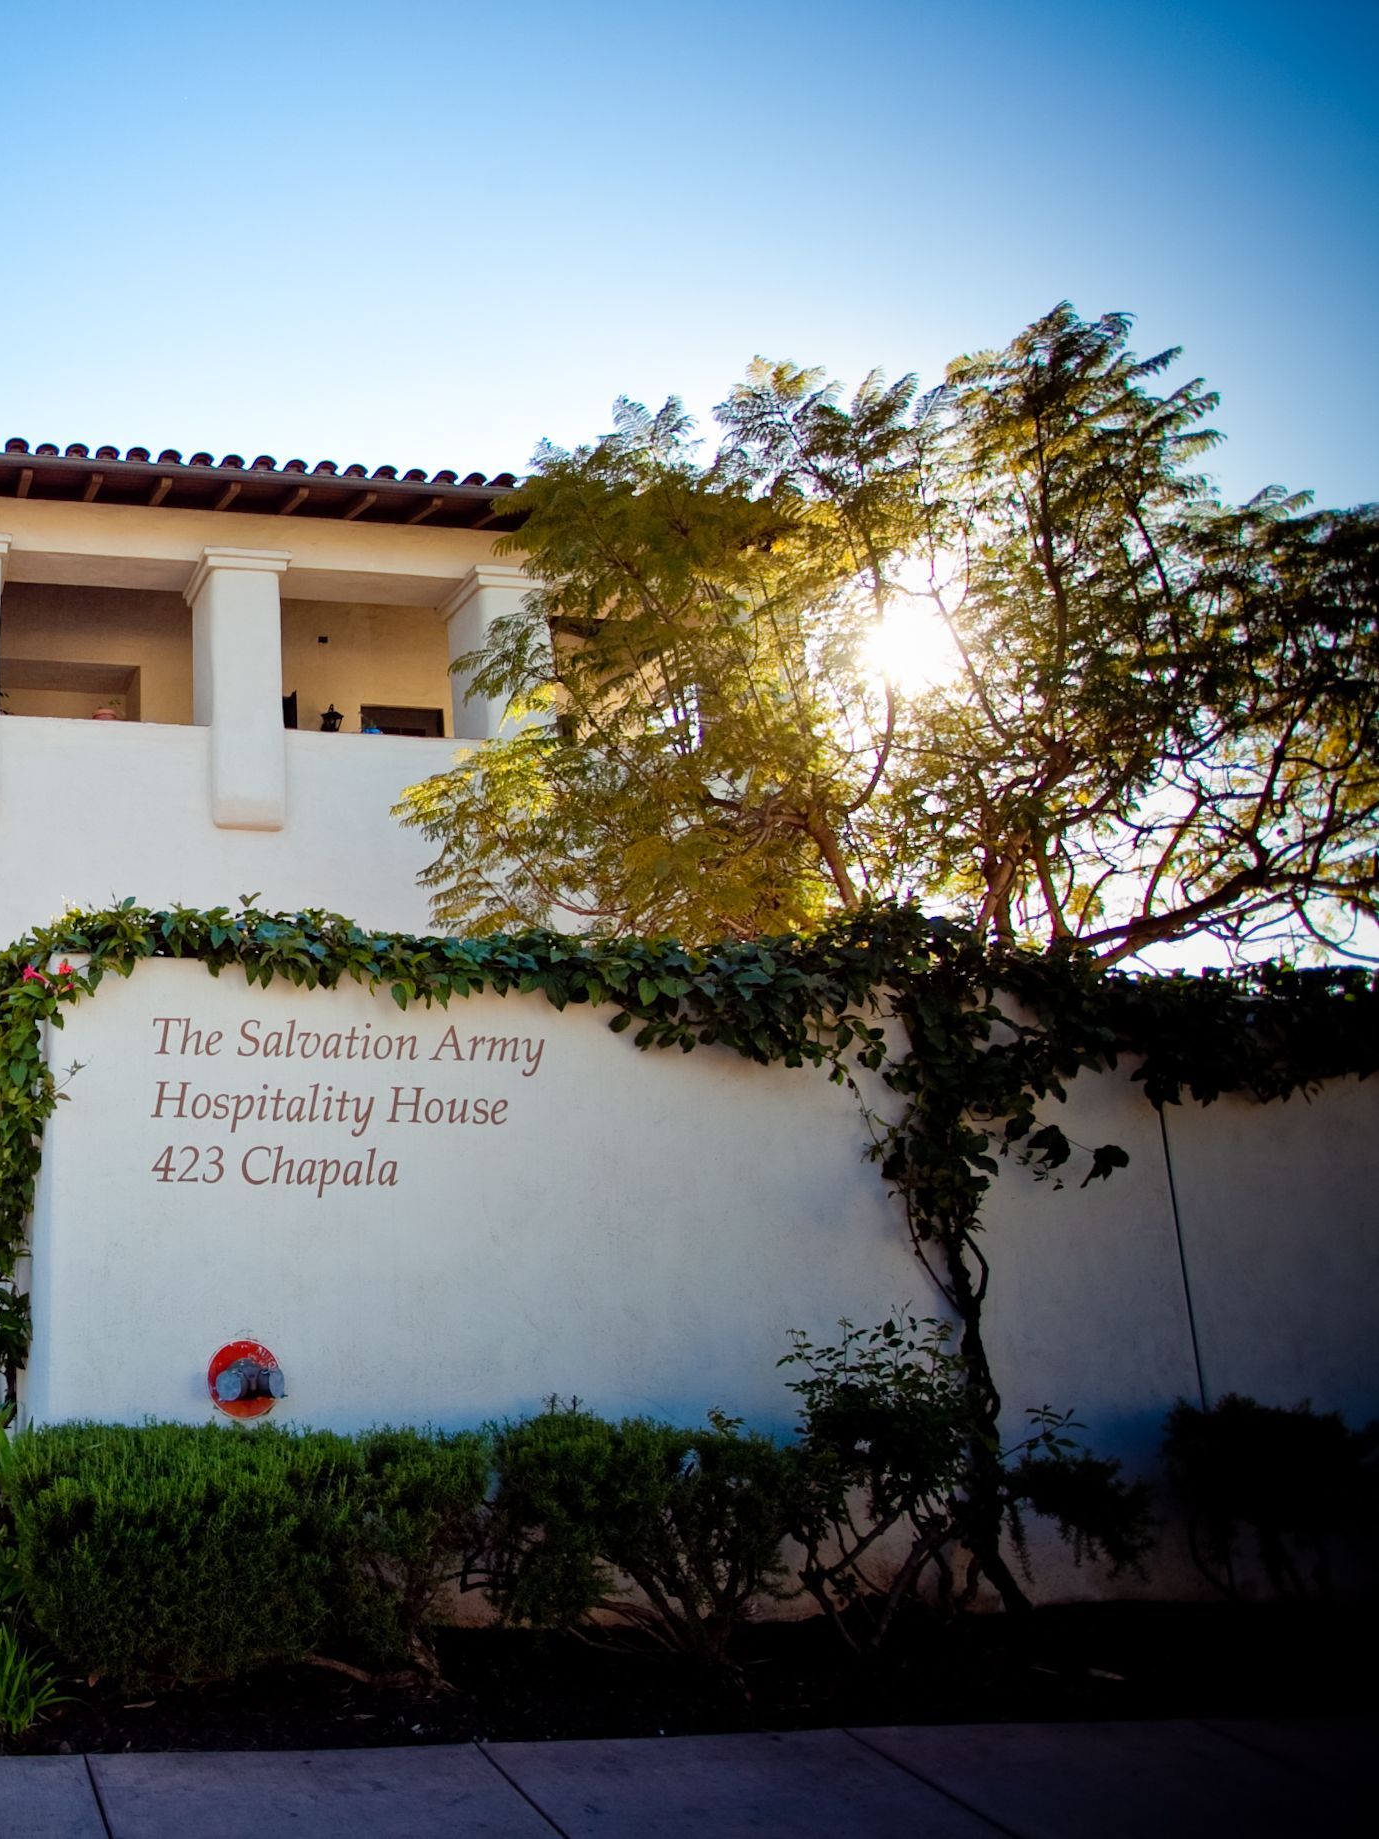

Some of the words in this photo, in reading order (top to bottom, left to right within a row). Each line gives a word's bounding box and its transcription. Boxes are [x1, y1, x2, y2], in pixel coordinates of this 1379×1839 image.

[152, 1017, 223, 1057] The
[237, 1018, 419, 1061] Salvation
[428, 1024, 546, 1078] Army
[150, 1080, 376, 1138] Hospitality
[386, 1086, 509, 1126] House
[151, 1145, 225, 1184] 423
[241, 1145, 399, 1199] Chapala
